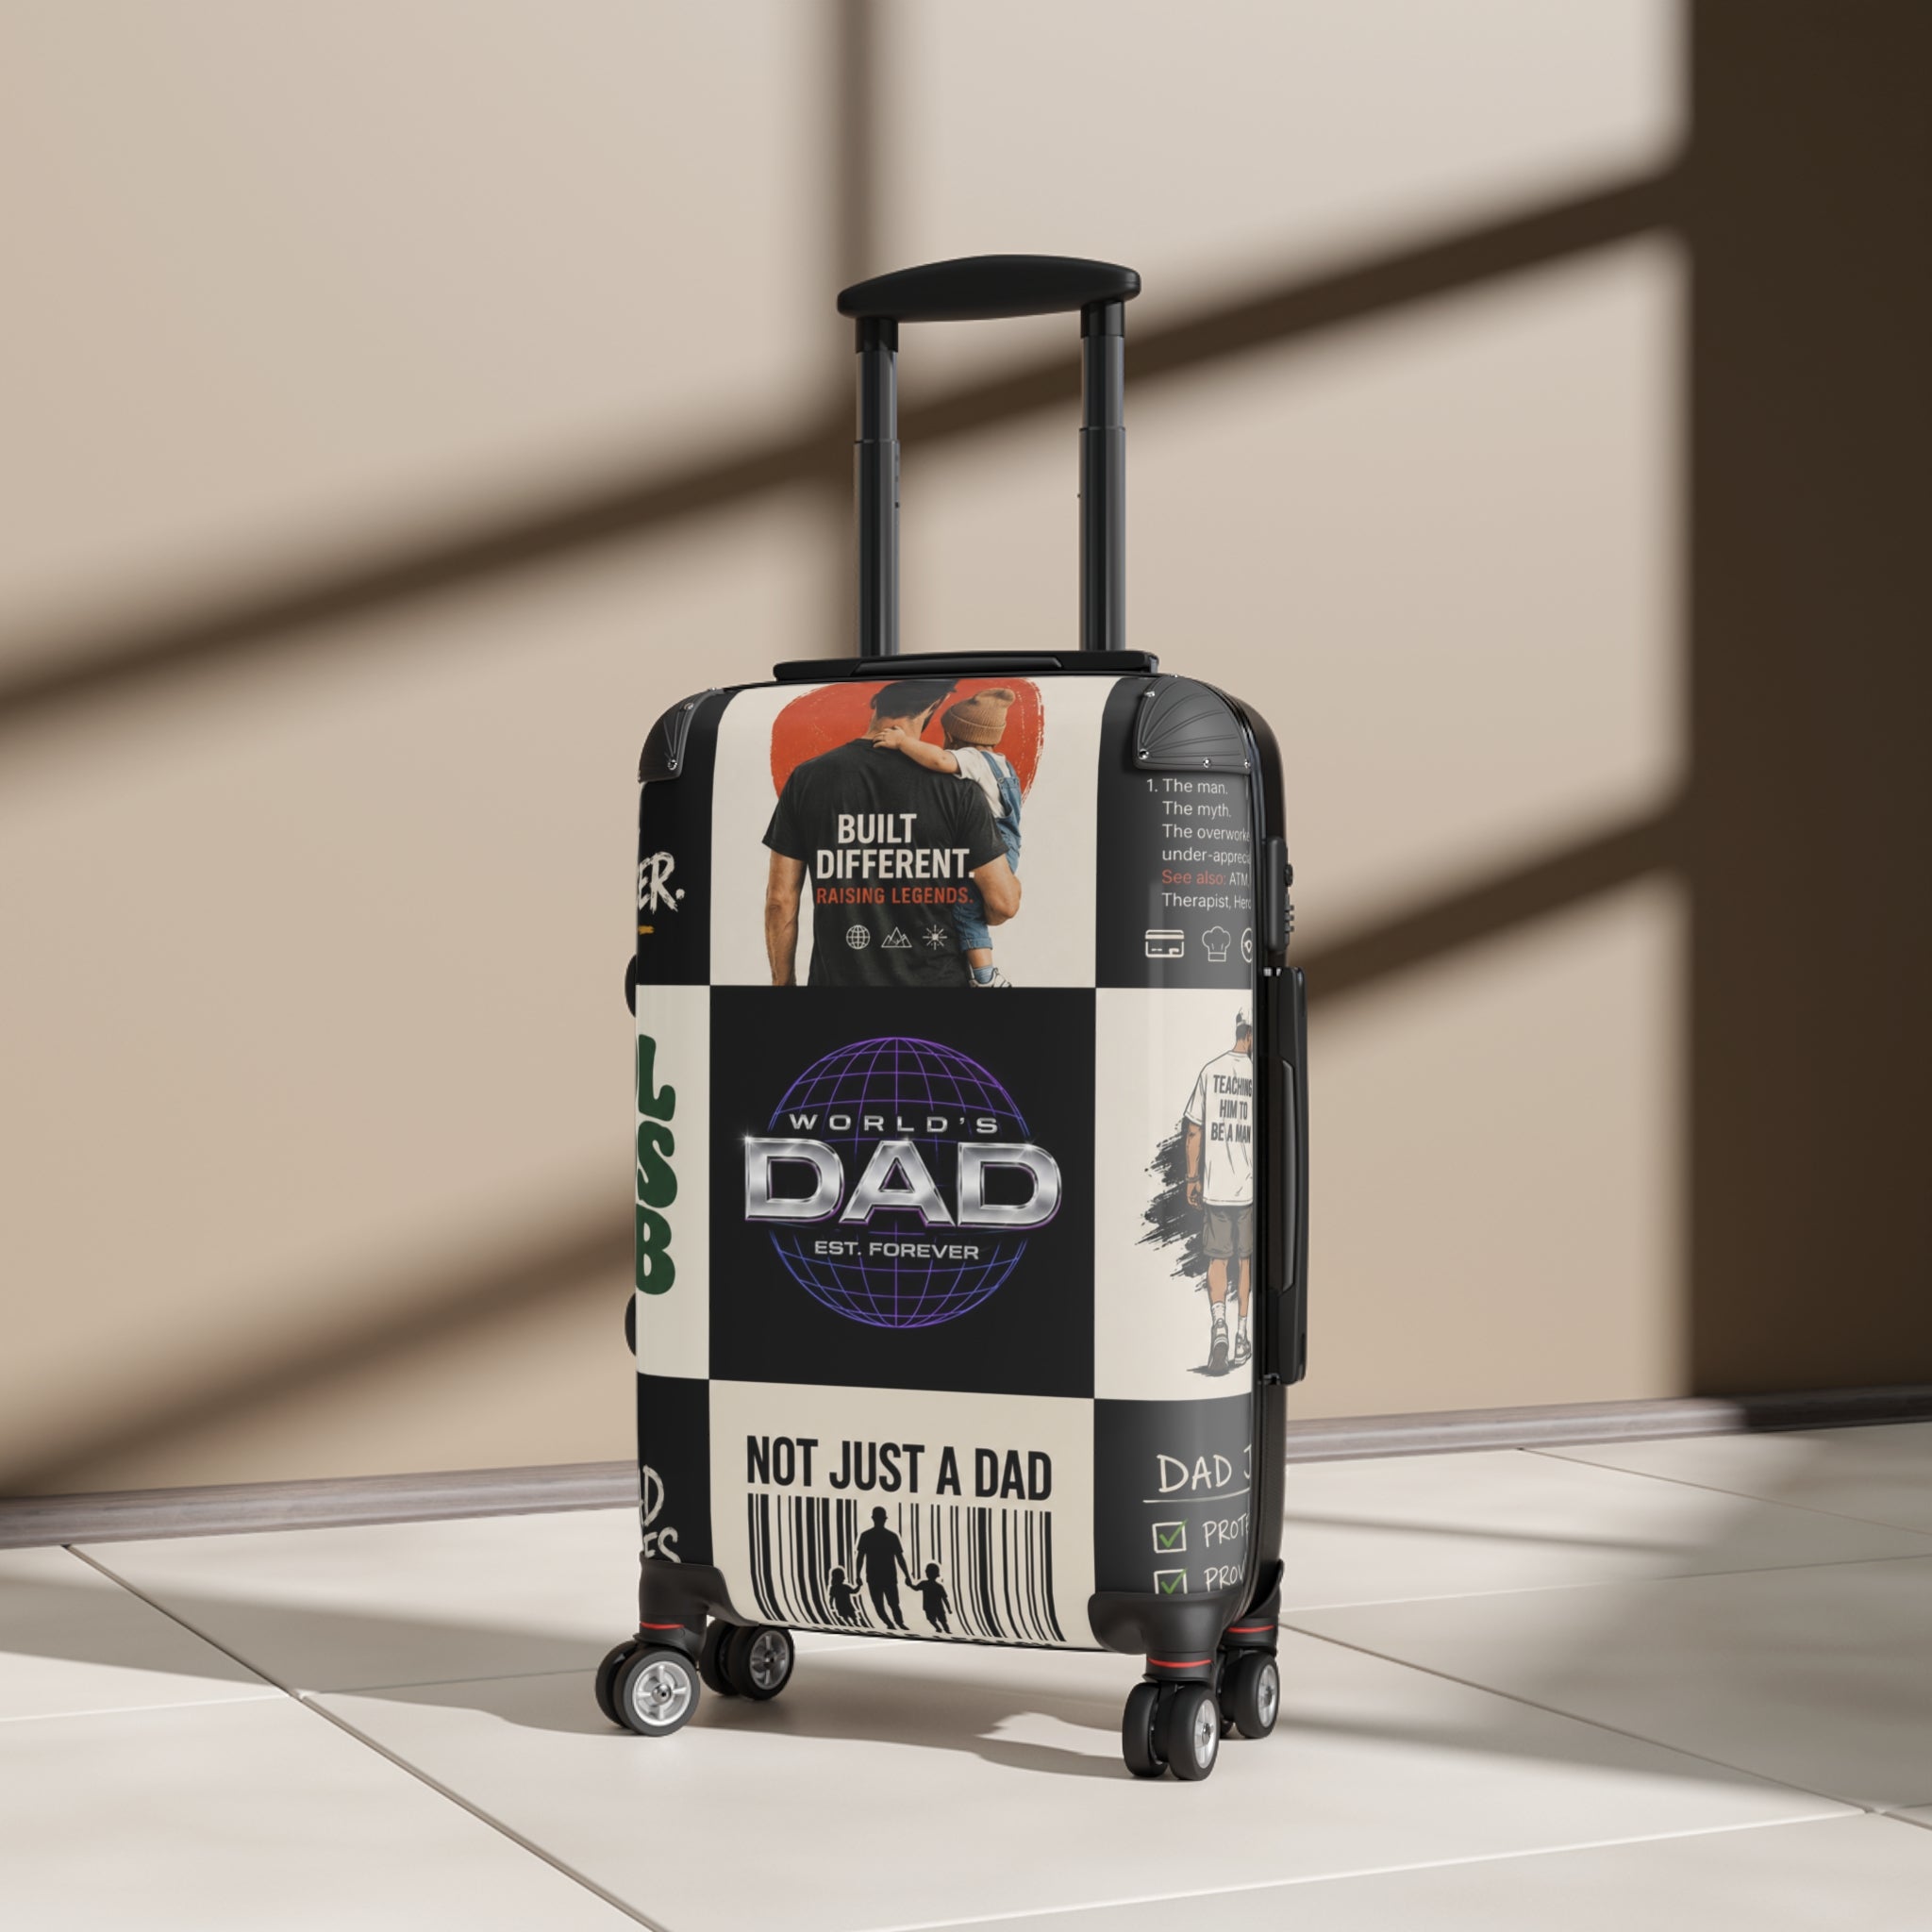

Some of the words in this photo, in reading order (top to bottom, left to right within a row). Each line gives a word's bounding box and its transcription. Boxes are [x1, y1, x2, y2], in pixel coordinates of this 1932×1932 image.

[1146, 778, 1158, 792] 1.
[1162, 778, 1193, 792] The
[1197, 782, 1228, 794] man.
[1162, 801, 1193, 815] The
[1197, 802, 1231, 820] myth.
[838, 813, 917, 844] BUILT
[1162, 824, 1193, 838] The
[816, 848, 975, 879] DIFFERENT.
[1161, 869, 1191, 884] See
[1196, 871, 1226, 885] also:
[816, 887, 886, 905] RAISING
[891, 887, 974, 905] LEGENDS.
[1162, 892, 1231, 910] Therapist,
[1213, 1075, 1252, 1097] TEACHING
[1220, 1099, 1238, 1118] HIM
[1240, 1101, 1248, 1120] TO
[1210, 1122, 1225, 1141] BE
[1226, 1123, 1233, 1142] A
[1235, 1124, 1251, 1143] MAN
[744, 1136, 1062, 1229] DAD
[814, 1241, 862, 1257] EST.
[868, 1241, 979, 1259] FOREVER
[746, 1435, 819, 1487] NOT
[829, 1441, 925, 1493] JUST
[936, 1445, 962, 1496] A
[974, 1447, 1053, 1502] DAD
[1157, 1454, 1232, 1492] DAD
[640, 1464, 665, 1527] D
